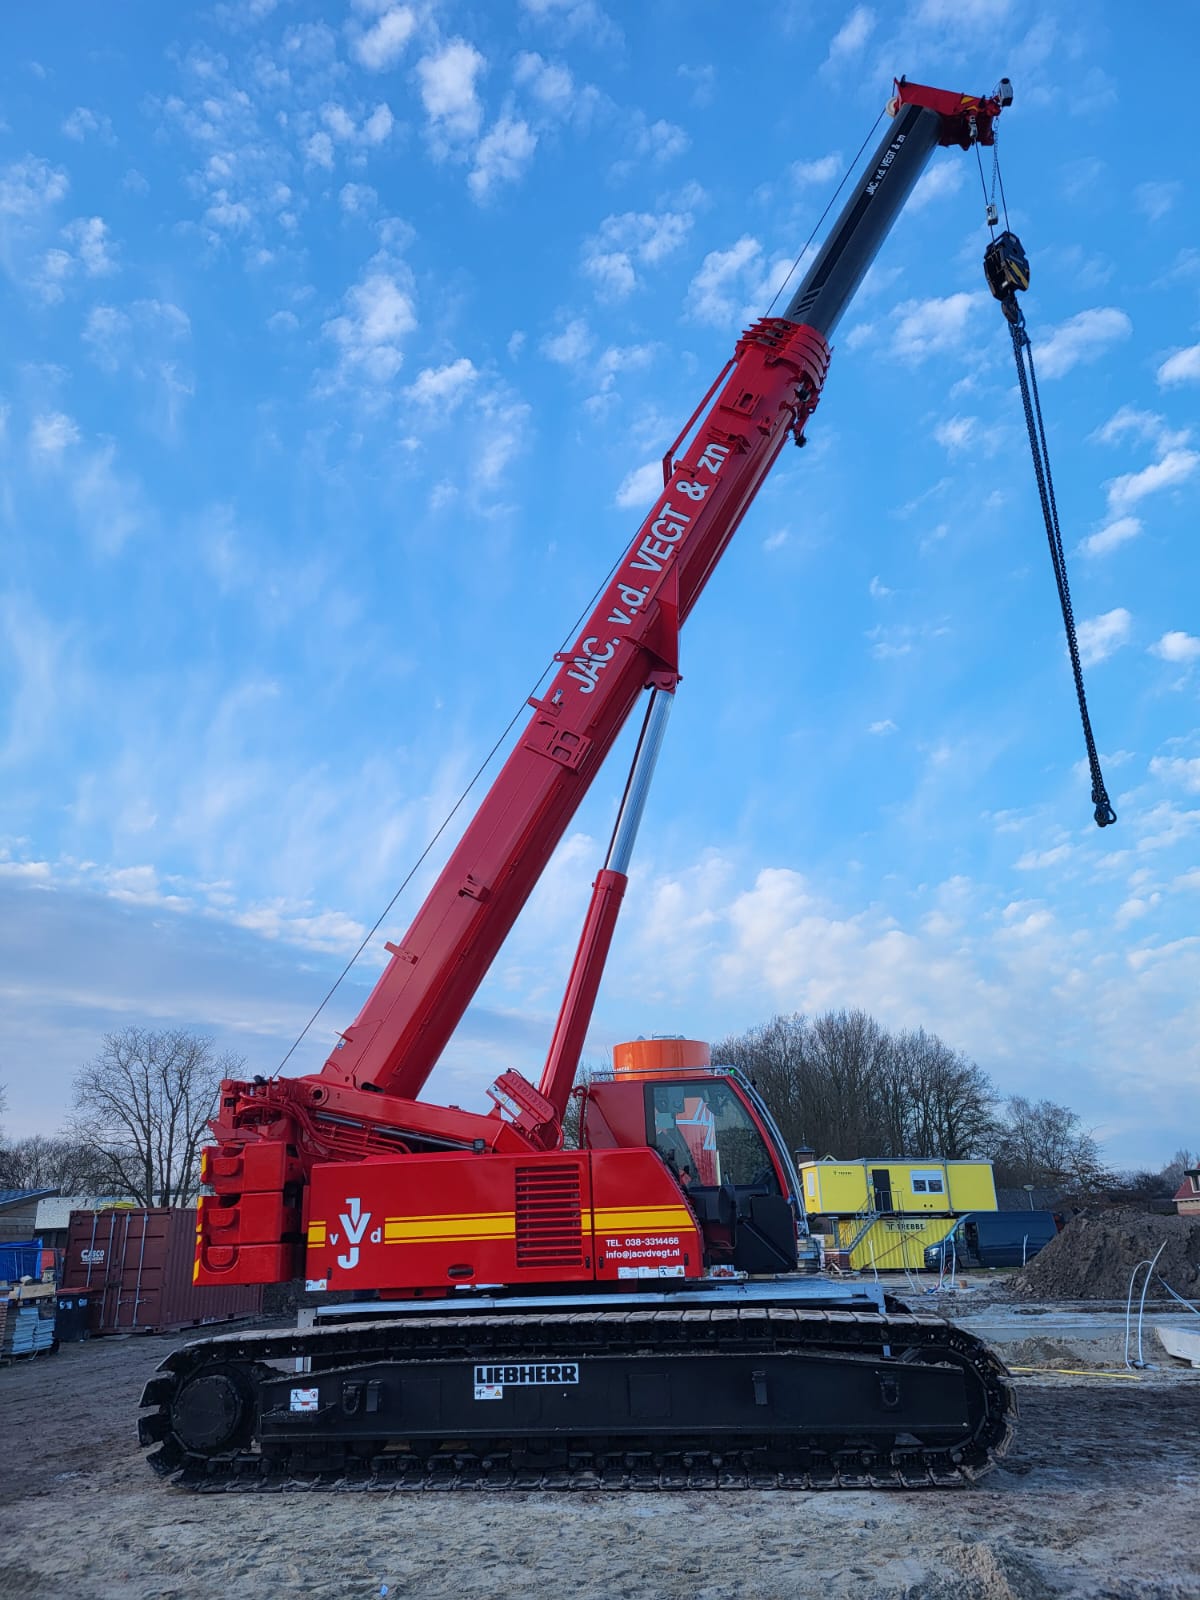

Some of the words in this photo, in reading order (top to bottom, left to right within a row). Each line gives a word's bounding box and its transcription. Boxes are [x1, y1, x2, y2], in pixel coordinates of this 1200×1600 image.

[880, 150, 897, 167] VEGT
[567, 636, 620, 694] JAC.
[607, 583, 649, 625] v.d.
[630, 502, 692, 573] VEGT
[676, 480, 710, 501] &
[697, 442, 730, 474] zn
[606, 1248, 680, 1259] info@jacvdvegt.nl
[475, 1365, 577, 1384] LIEBHERR
